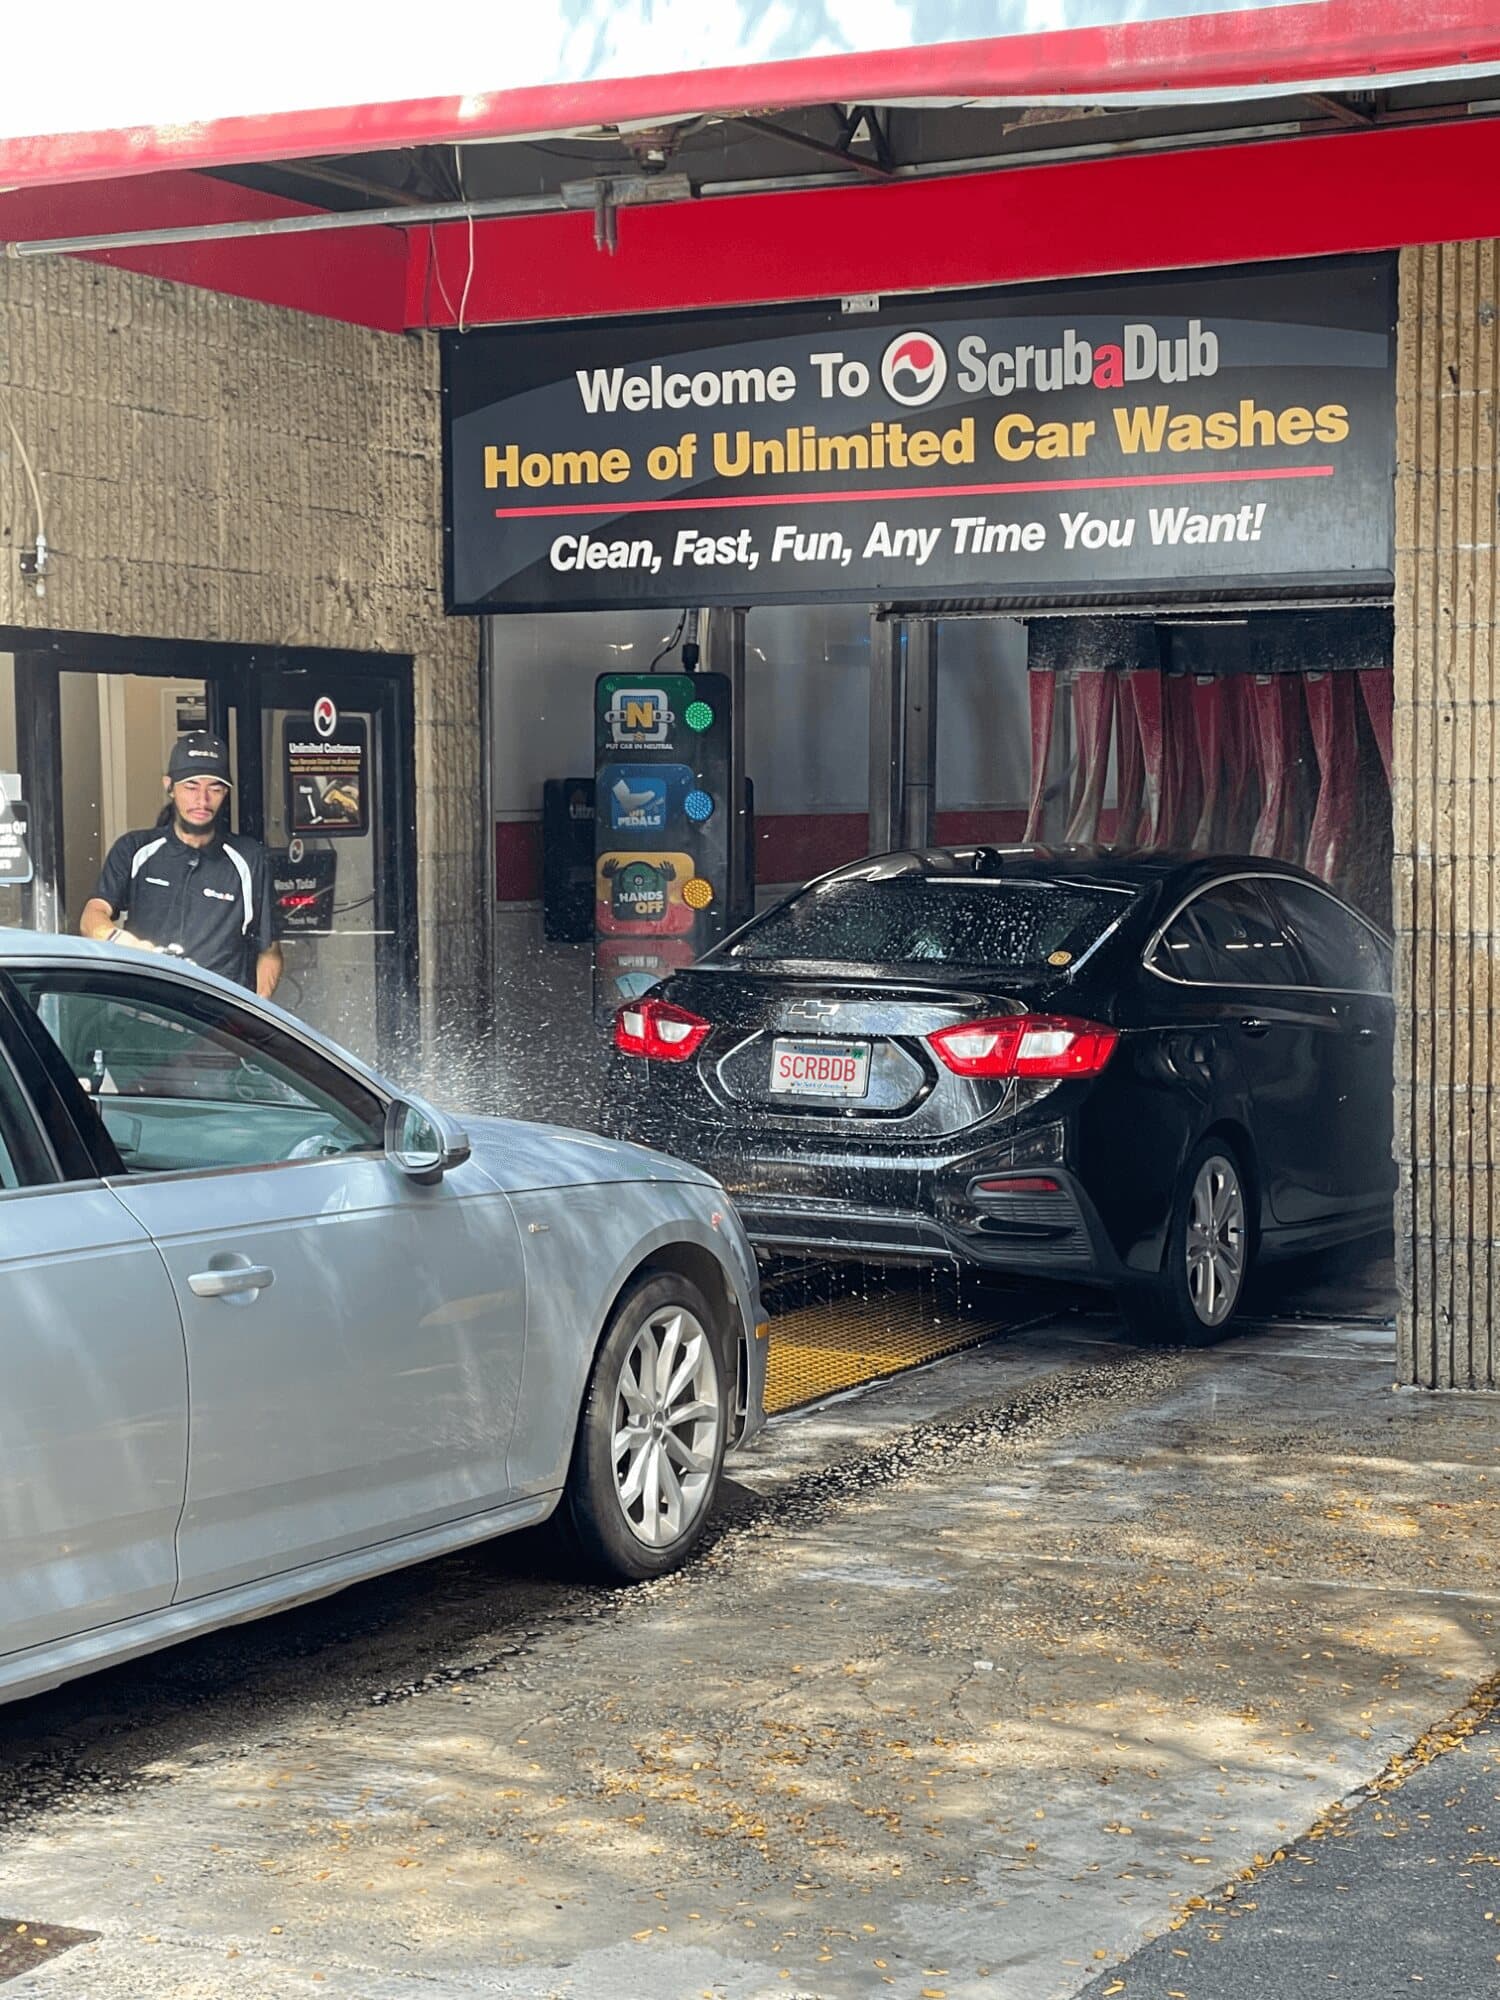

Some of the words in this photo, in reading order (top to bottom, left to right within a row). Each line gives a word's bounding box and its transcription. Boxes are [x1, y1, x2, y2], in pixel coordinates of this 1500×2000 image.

[575, 365, 797, 414] Welcome
[809, 352, 870, 398] To
[956, 319, 1219, 397] ScrubaDub
[484, 444, 632, 489] Home
[647, 433, 697, 480] of
[713, 417, 976, 479] Unlimited
[993, 413, 1096, 462] Car
[1112, 399, 1350, 455] Washes
[549, 534, 662, 574] Clean,
[672, 528, 760, 571] Fast,
[771, 525, 853, 566] Fun,
[862, 520, 942, 566] Any
[951, 516, 1046, 555] Time
[1058, 511, 1135, 550] You
[1148, 503, 1267, 546] Want!
[626, 701, 653, 728] N
[617, 815, 661, 827] PEDALS
[619, 891, 663, 902] HANDS
[635, 902, 664, 914] OFF
[780, 1056, 855, 1081] SCRBDB
